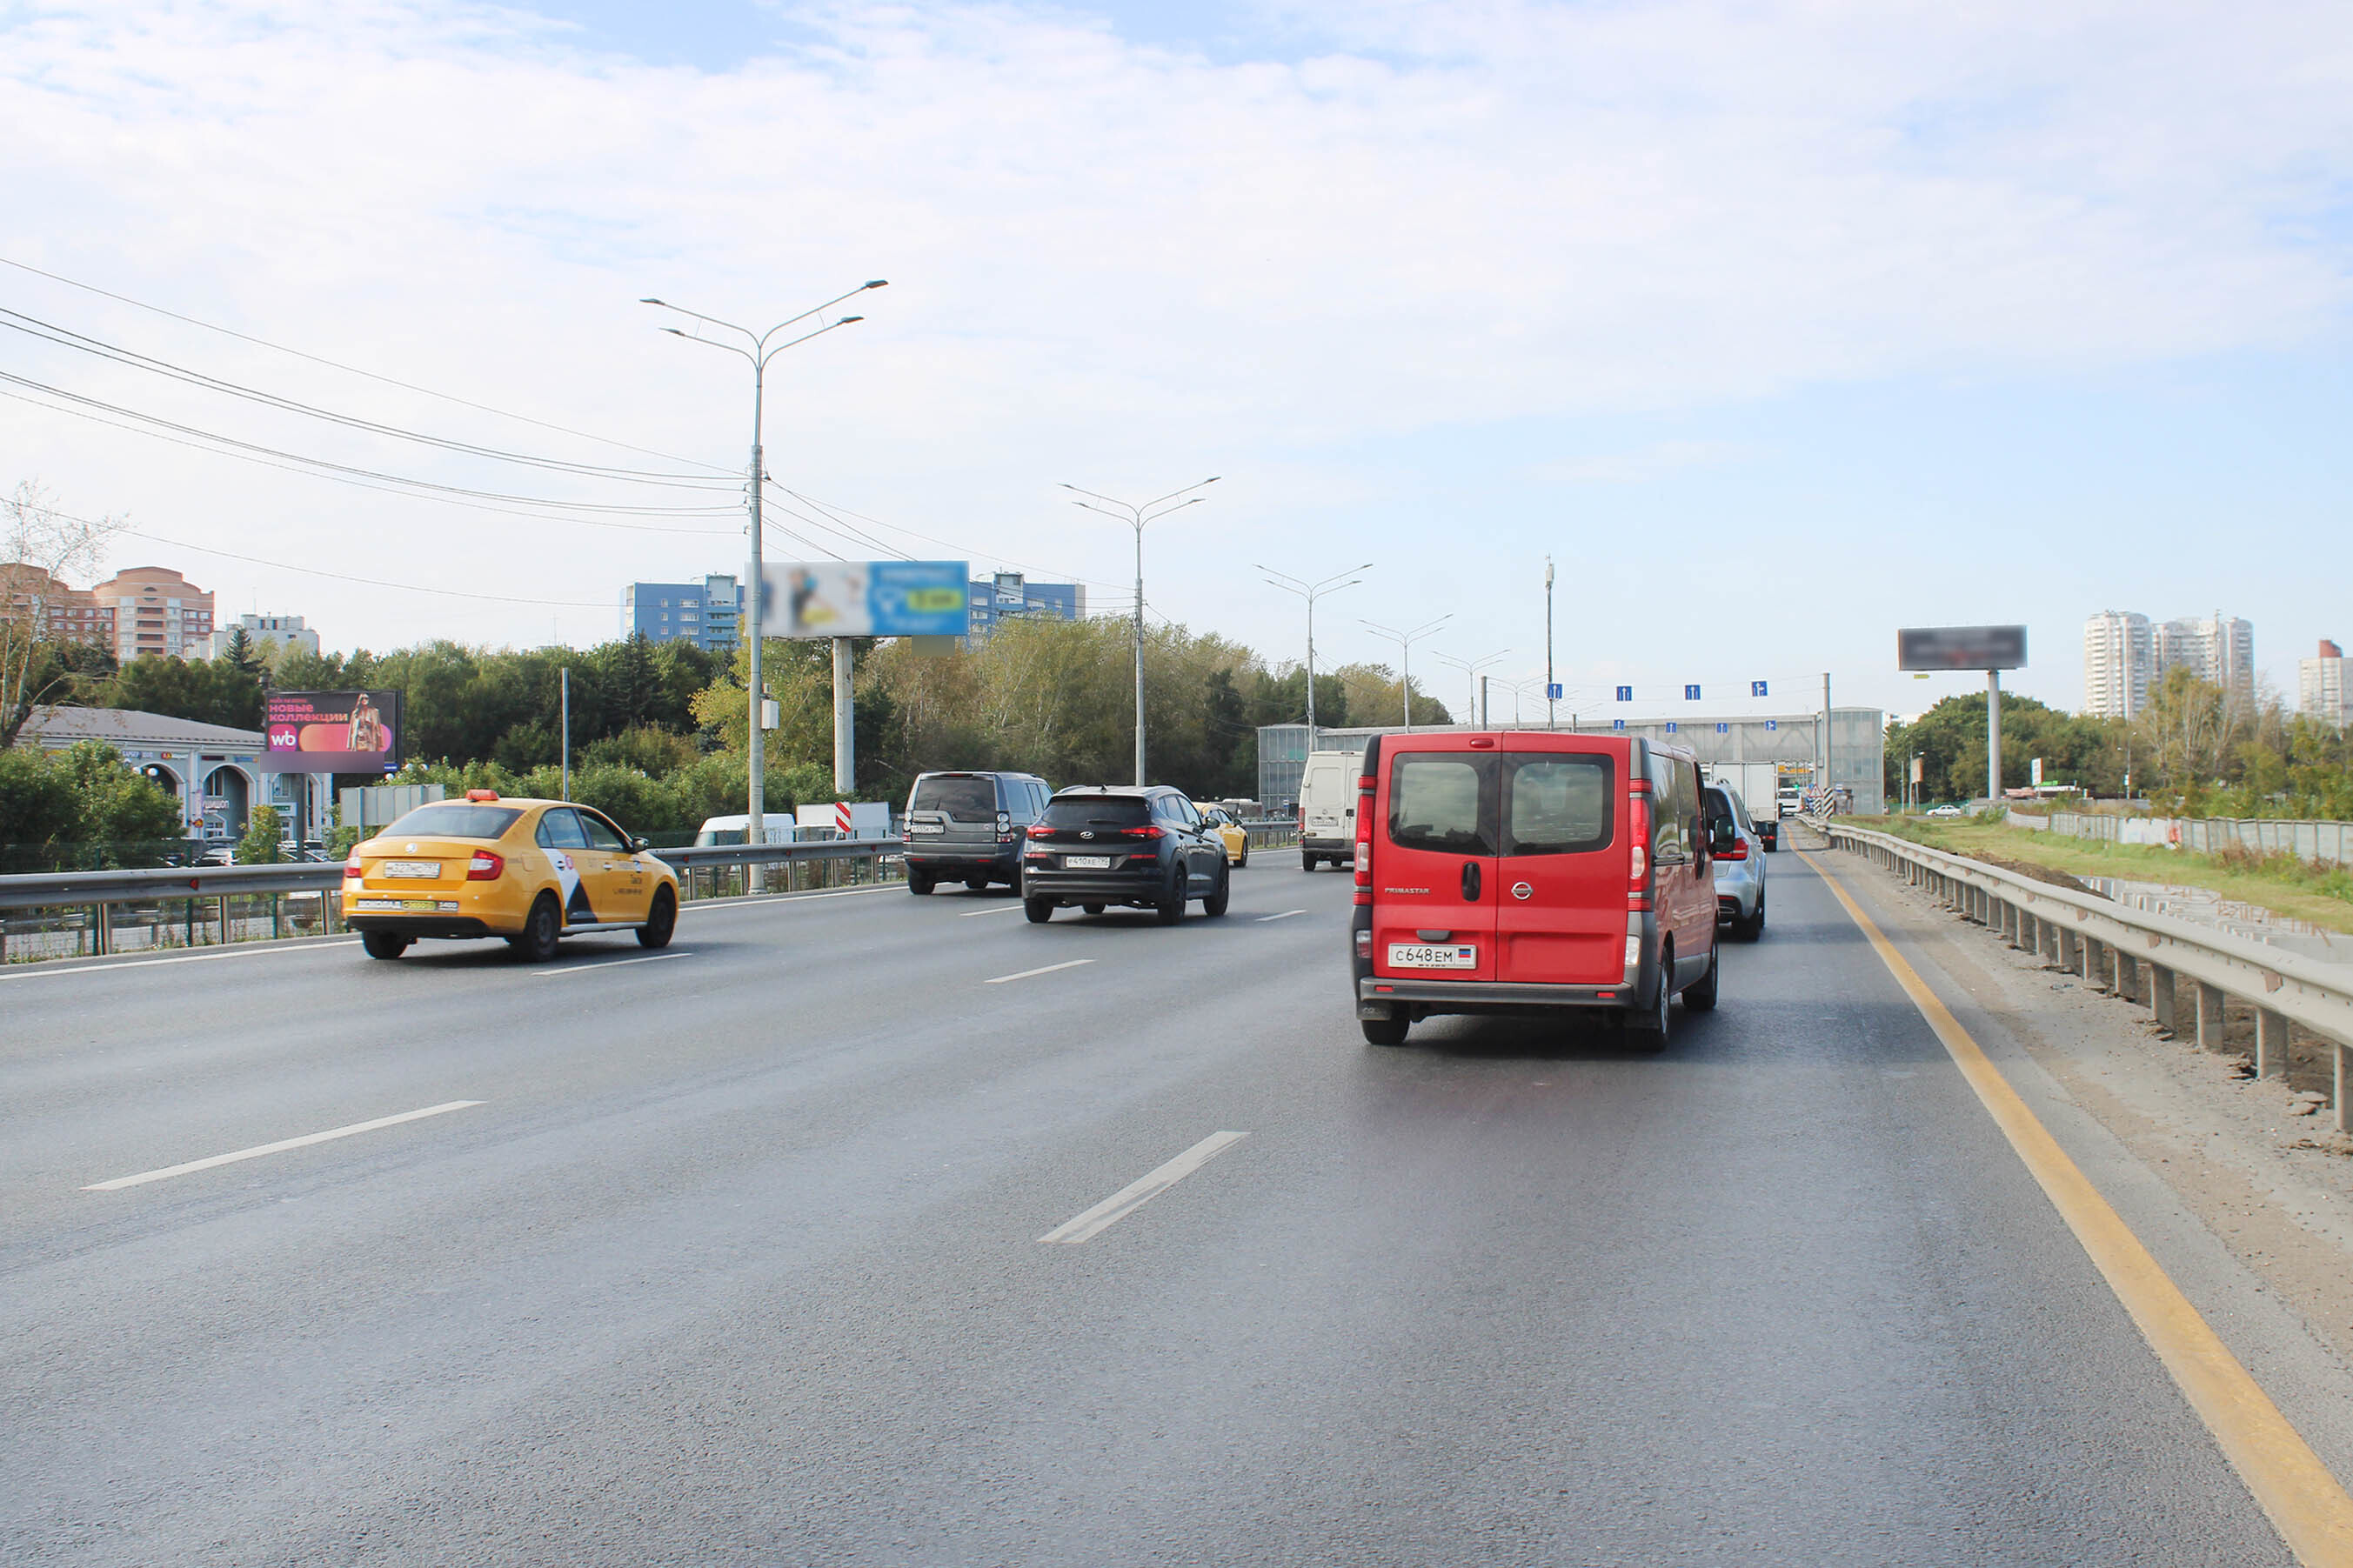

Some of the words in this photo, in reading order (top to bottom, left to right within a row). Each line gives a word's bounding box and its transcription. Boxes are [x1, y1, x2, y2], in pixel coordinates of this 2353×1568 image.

[268, 704, 314, 713] новые
[268, 713, 349, 724] коллекции
[271, 731, 296, 746] wb
